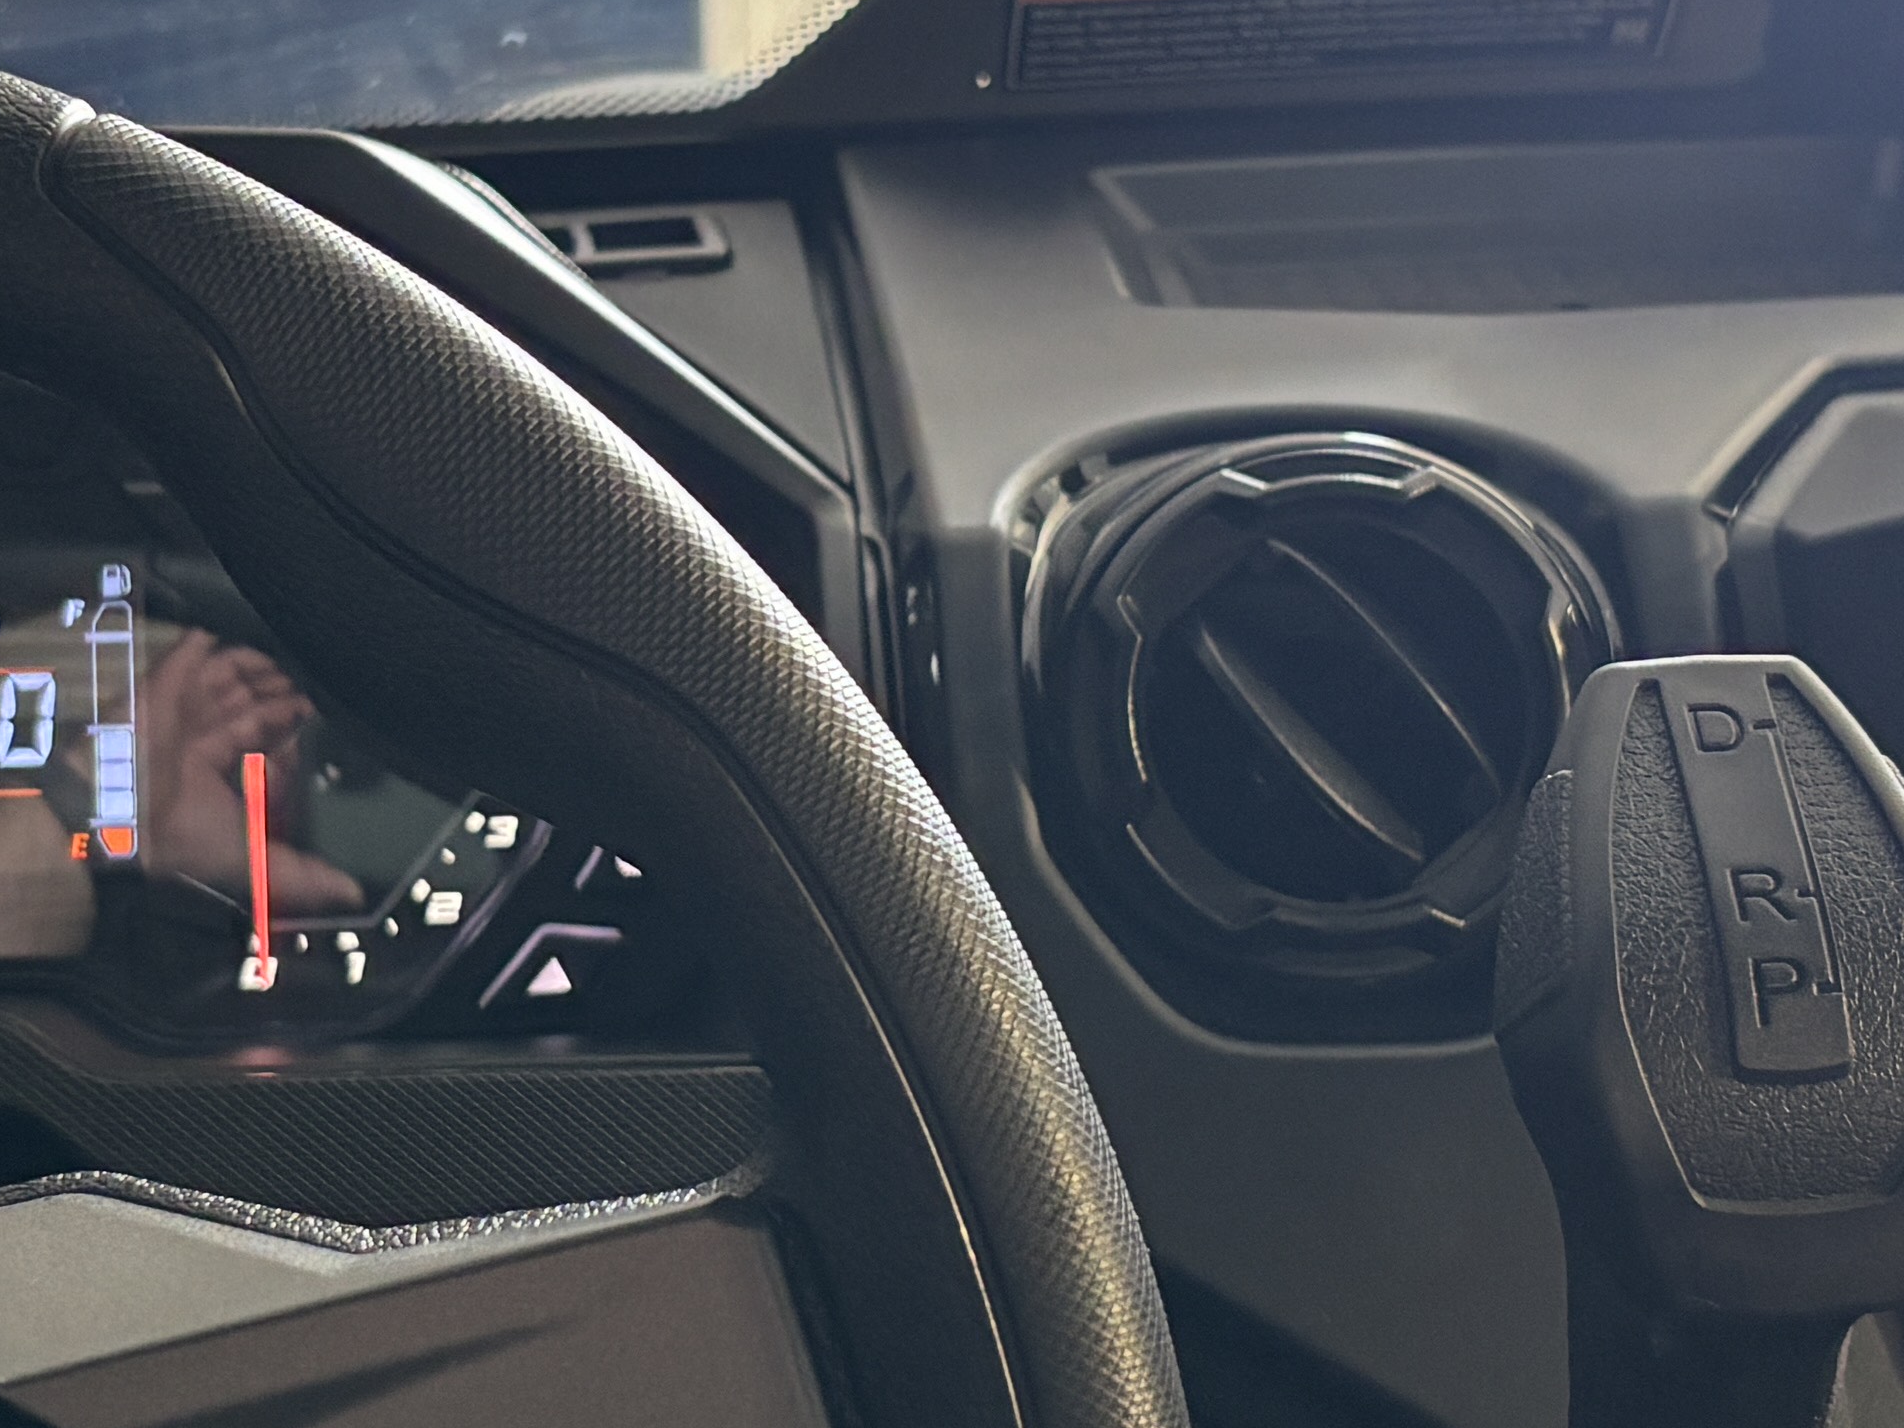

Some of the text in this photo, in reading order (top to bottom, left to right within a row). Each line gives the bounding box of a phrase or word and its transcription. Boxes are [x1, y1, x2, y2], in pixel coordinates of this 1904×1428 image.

[61, 598, 86, 629] F
[1686, 702, 1746, 753] D
[70, 832, 89, 860] E
[1727, 867, 1799, 924] R
[345, 951, 366, 986] 1
[1748, 956, 1806, 1029] P
